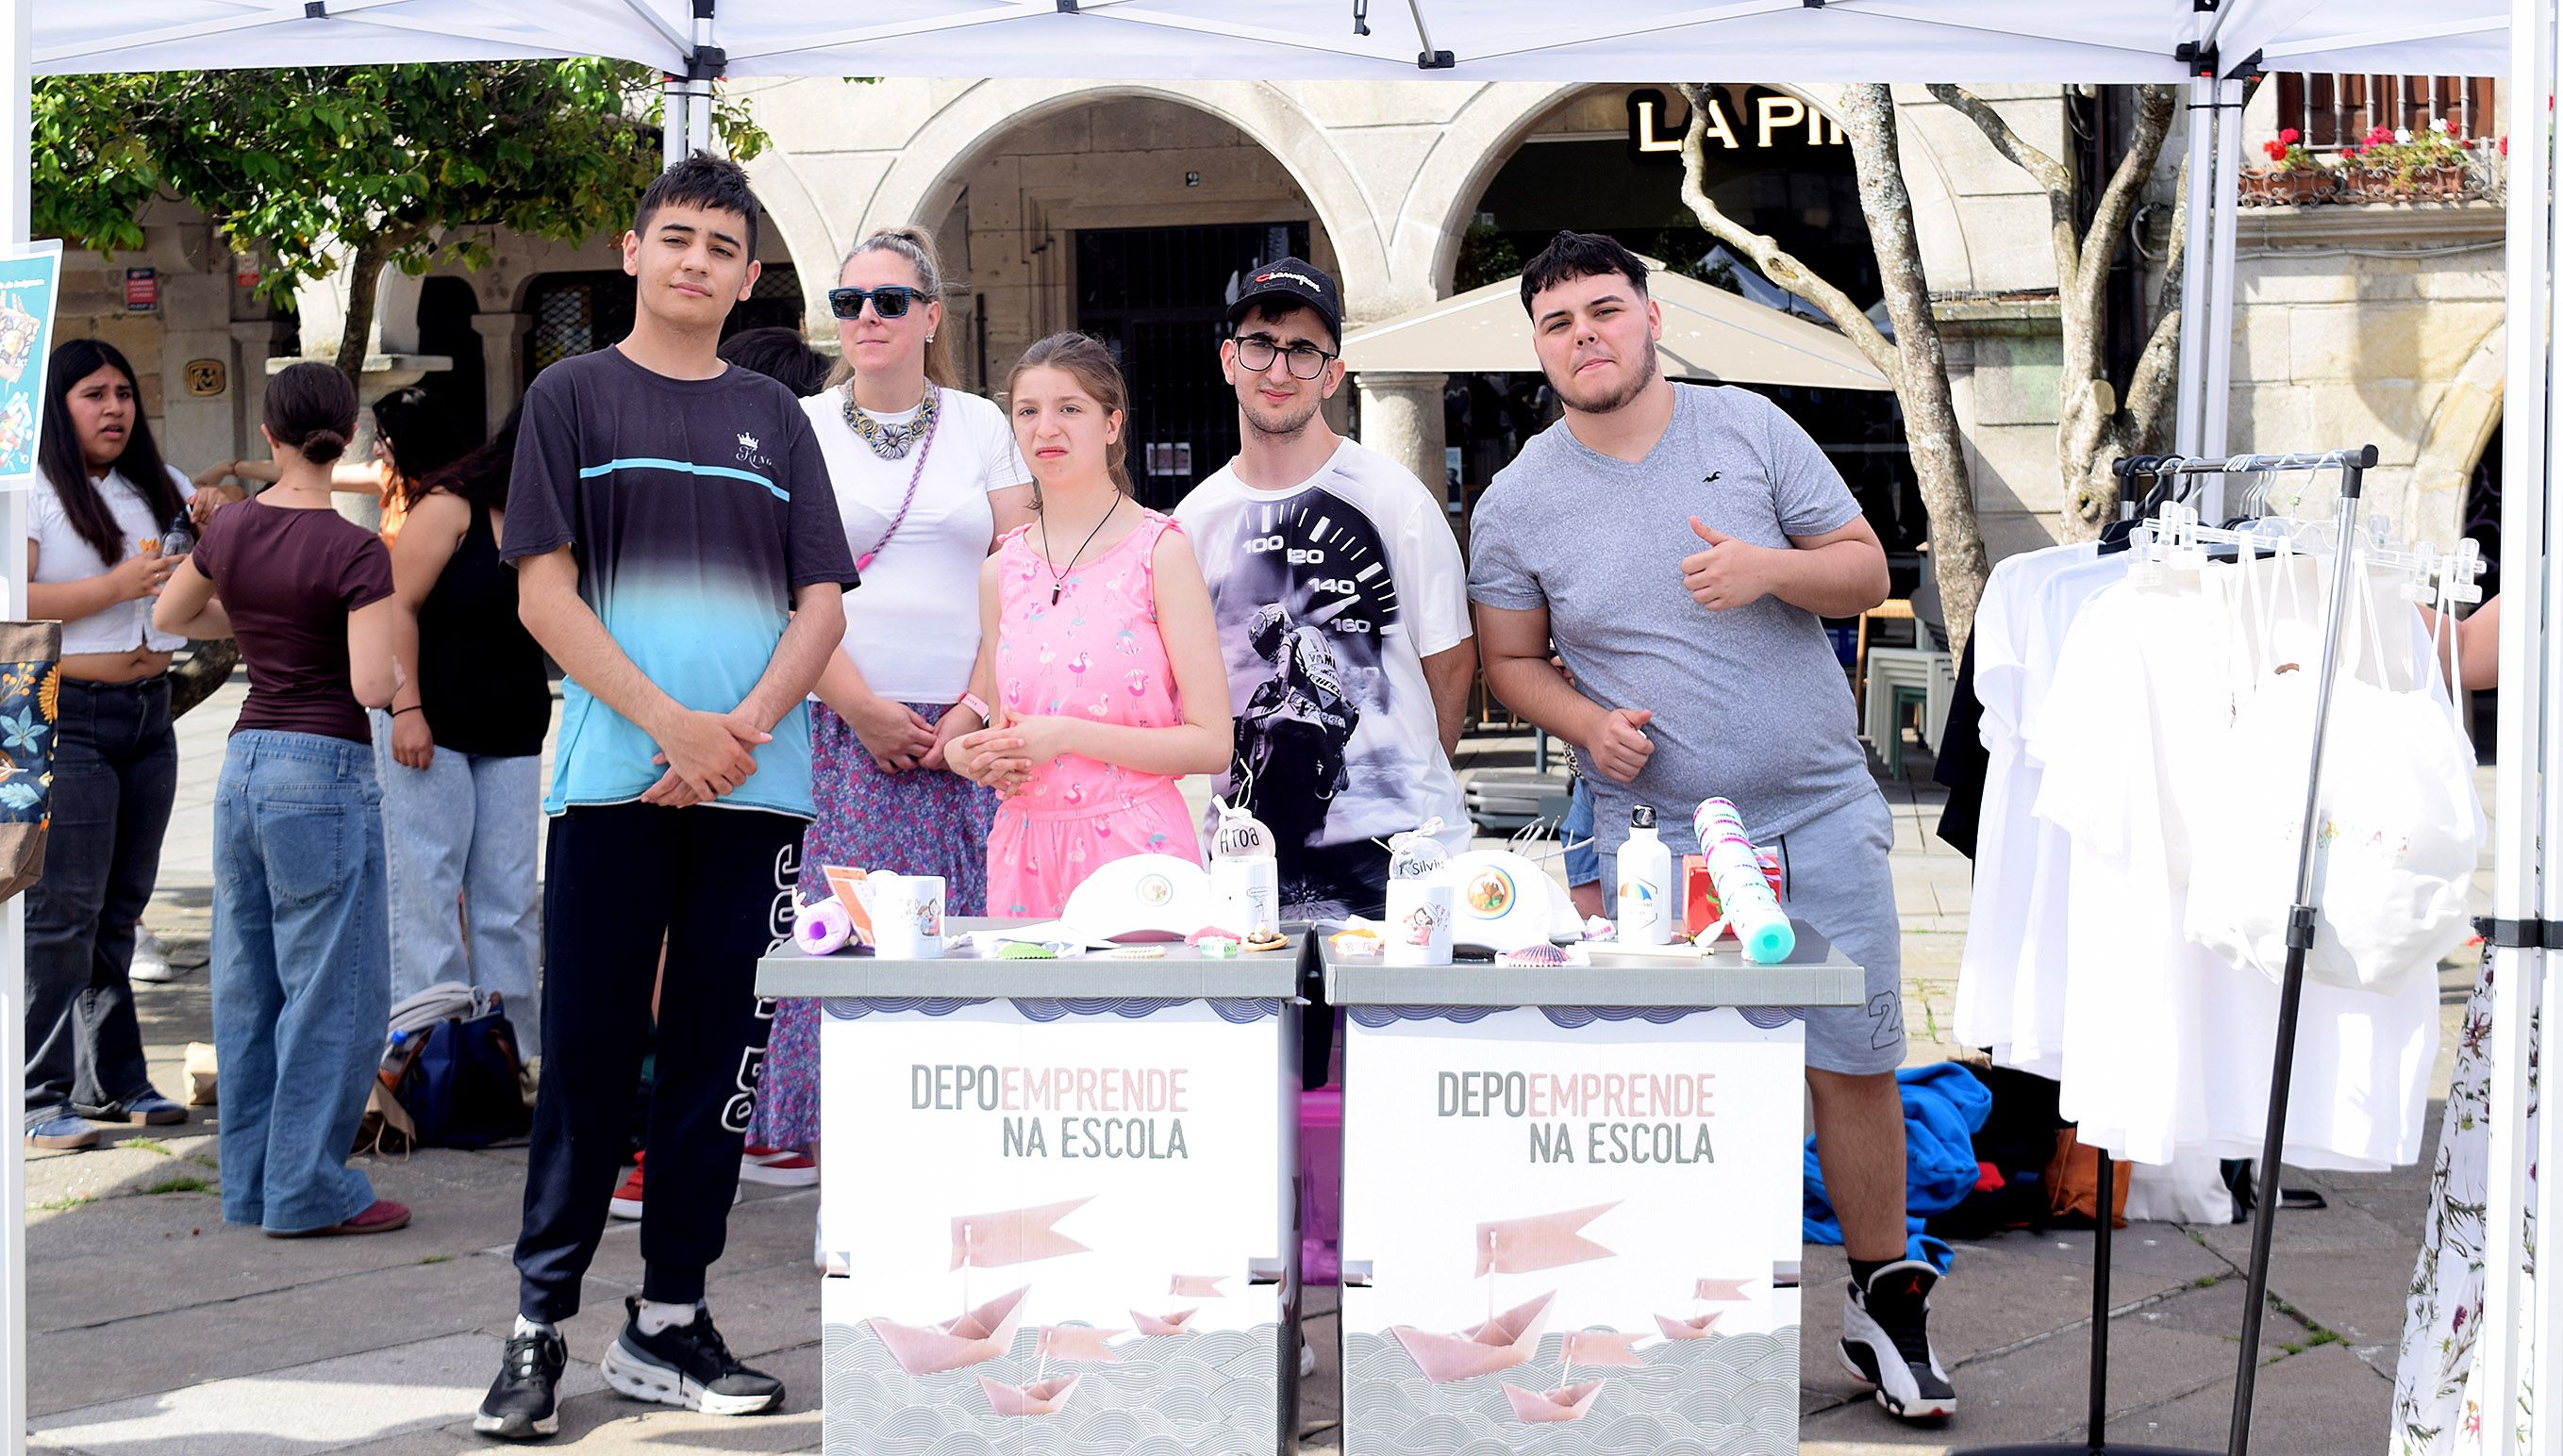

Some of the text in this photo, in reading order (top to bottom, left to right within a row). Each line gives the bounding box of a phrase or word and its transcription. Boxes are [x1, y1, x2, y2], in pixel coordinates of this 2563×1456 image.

[1638, 98, 1739, 152] LA
[1242, 535, 1284, 554] 100
[1287, 548, 1324, 564] 120
[1307, 577, 1356, 594] 140
[1330, 618, 1371, 633] 160
[1220, 826, 1260, 854] Aroa
[1868, 989, 1905, 1051] 2
[911, 1064, 1189, 1113] DEPOEMPRENDE
[1438, 1070, 1716, 1118] DEPOEMPRENDE
[1003, 1116, 1189, 1160] NA ESCOLA
[1529, 1121, 1715, 1165] NA ESCOLA
